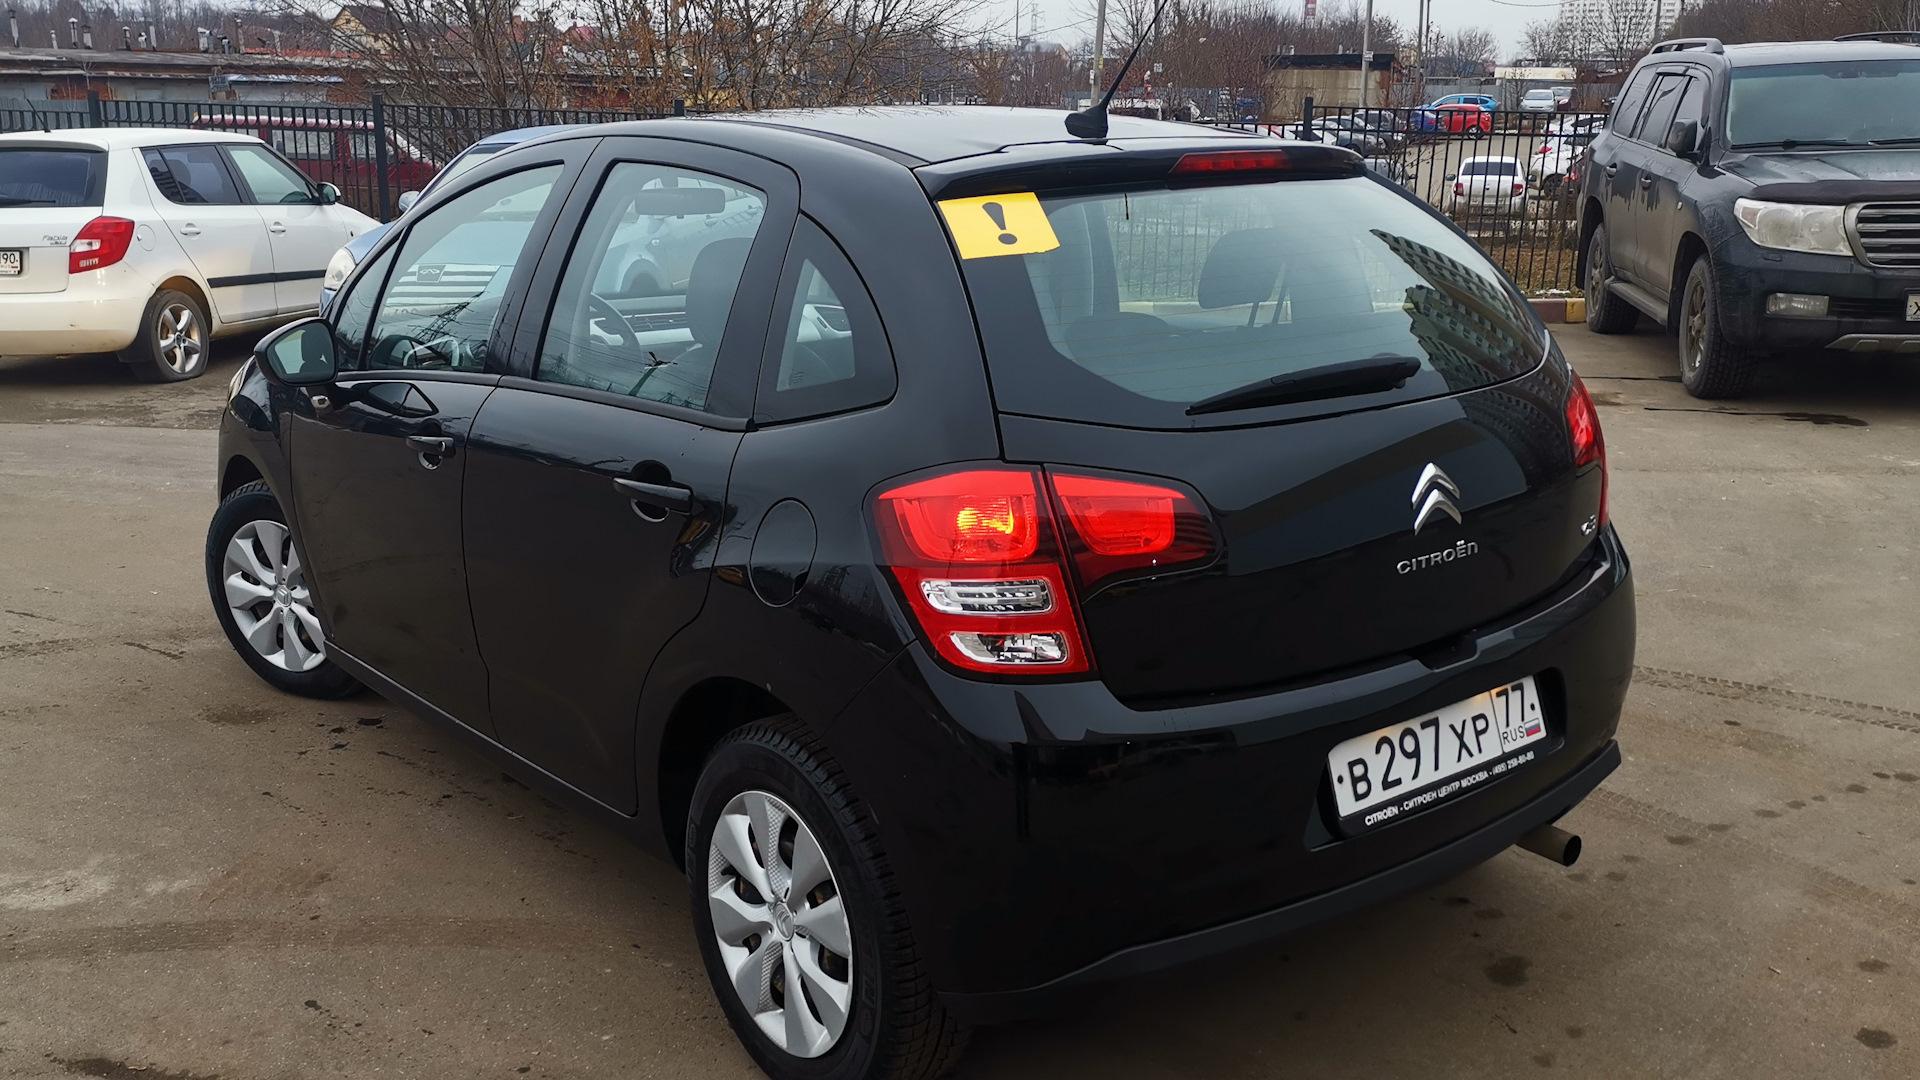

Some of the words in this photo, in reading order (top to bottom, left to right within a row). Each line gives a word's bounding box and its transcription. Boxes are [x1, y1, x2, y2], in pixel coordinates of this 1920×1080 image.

[1495, 682, 1526, 728] 77
[1502, 726, 1526, 746] RUS
[1437, 780, 1460, 798] ЦЕНТР
[1460, 771, 1489, 789] МОСКВА
